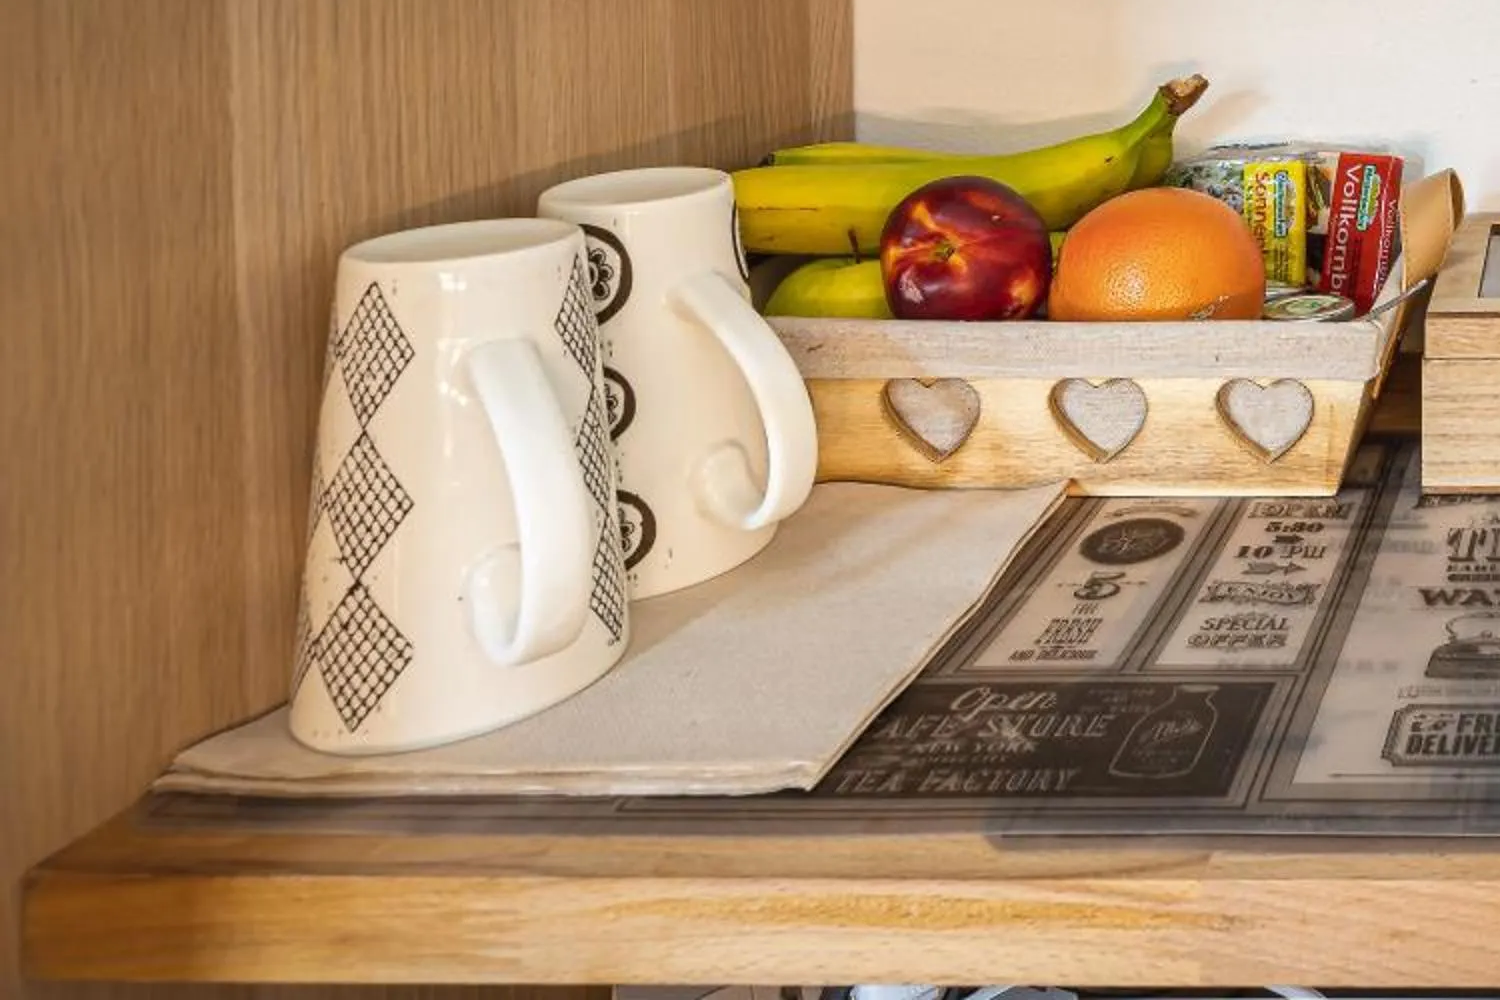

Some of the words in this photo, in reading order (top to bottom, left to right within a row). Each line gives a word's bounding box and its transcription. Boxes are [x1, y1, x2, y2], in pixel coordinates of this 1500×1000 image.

[1253, 171, 1272, 254] Sonnen
[1329, 163, 1362, 296] Vollkornbr
[1233, 545, 1274, 559] 10
[1073, 571, 1126, 600] 5
[1200, 617, 1289, 631] SPECIAL
[950, 686, 1058, 722] Open
[873, 714, 956, 739] AFE
[978, 713, 1118, 739] STORE
[835, 769, 908, 793] TEA
[918, 768, 1081, 793] FACTORY
